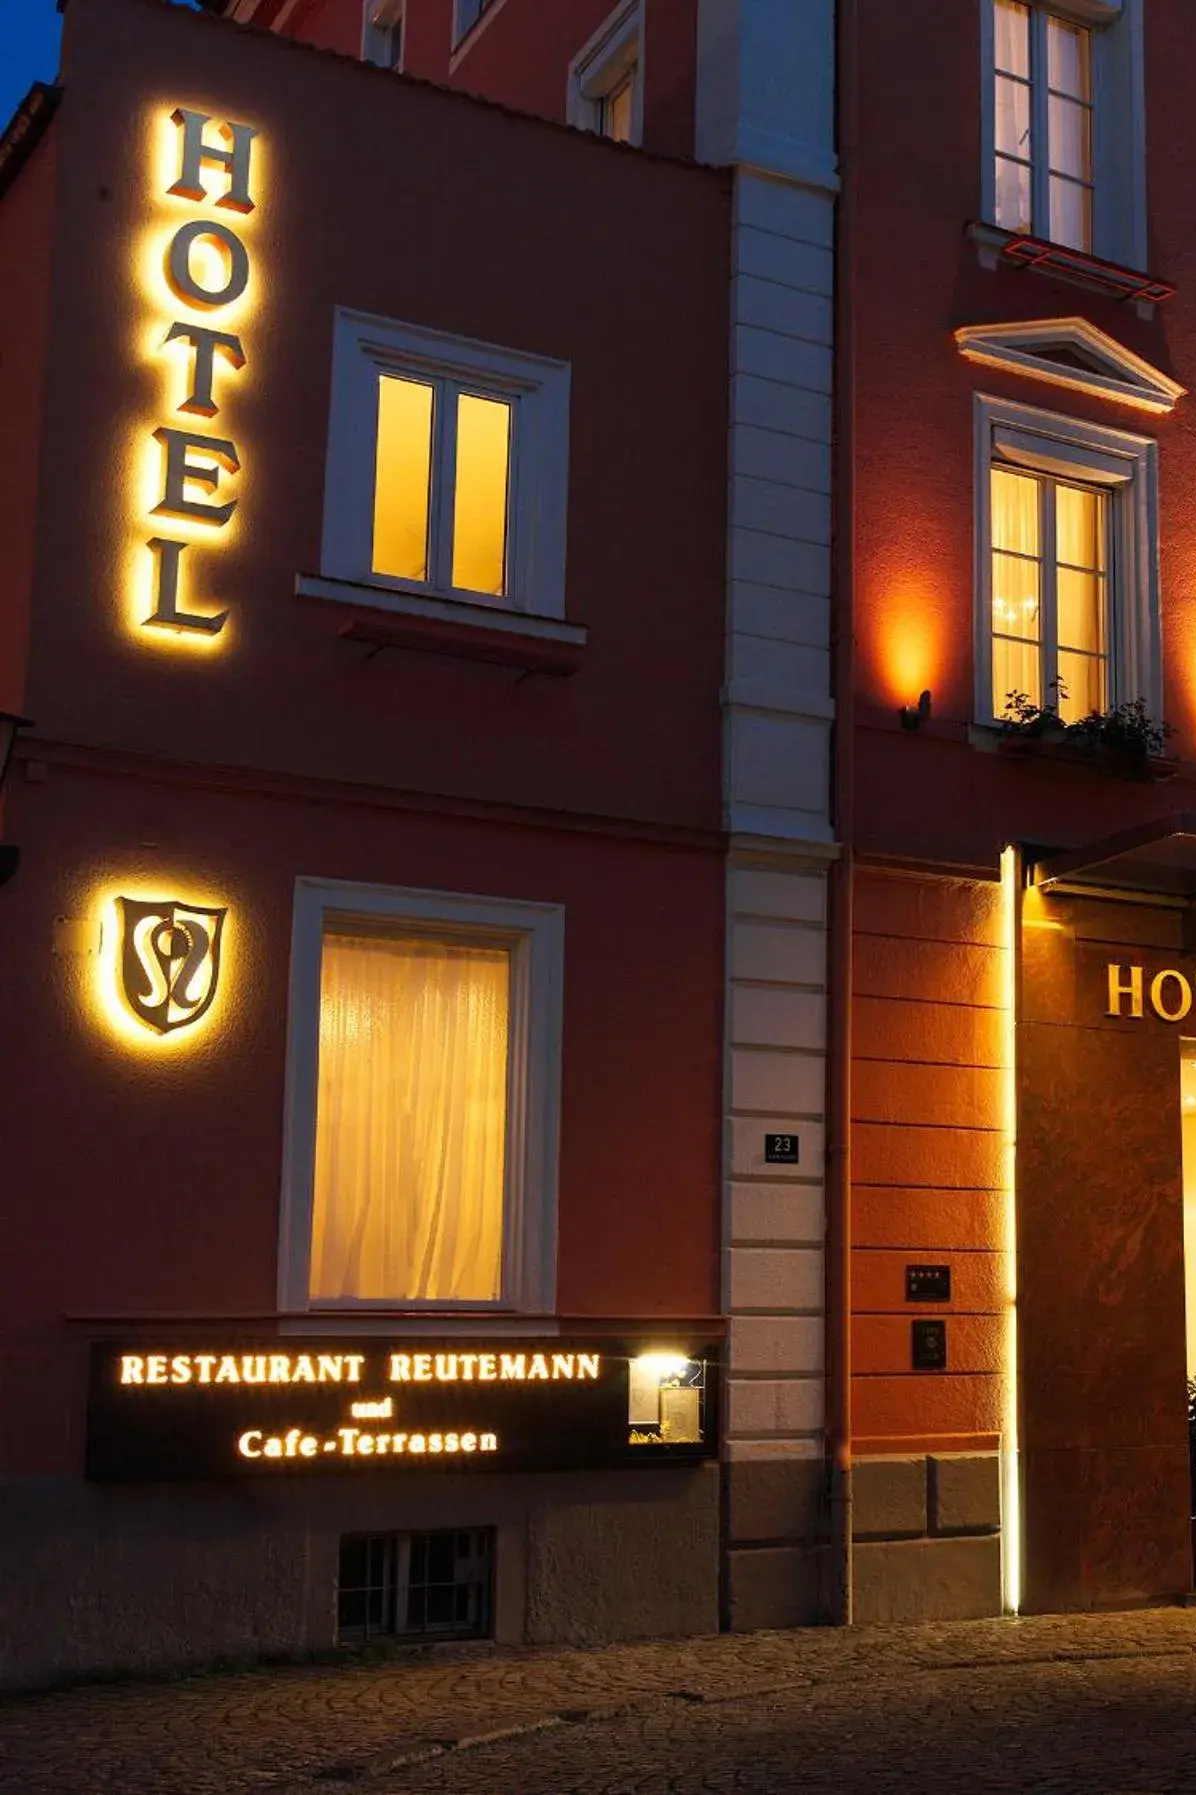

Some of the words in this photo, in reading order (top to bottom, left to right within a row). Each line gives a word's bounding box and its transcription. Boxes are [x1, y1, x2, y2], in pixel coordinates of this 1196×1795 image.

[141, 107, 260, 636] HOTEL
[774, 1137, 791, 1152] 23
[120, 1354, 364, 1384] RESTAURANT
[390, 1352, 600, 1381] REUTEMANN
[352, 1397, 392, 1418] und
